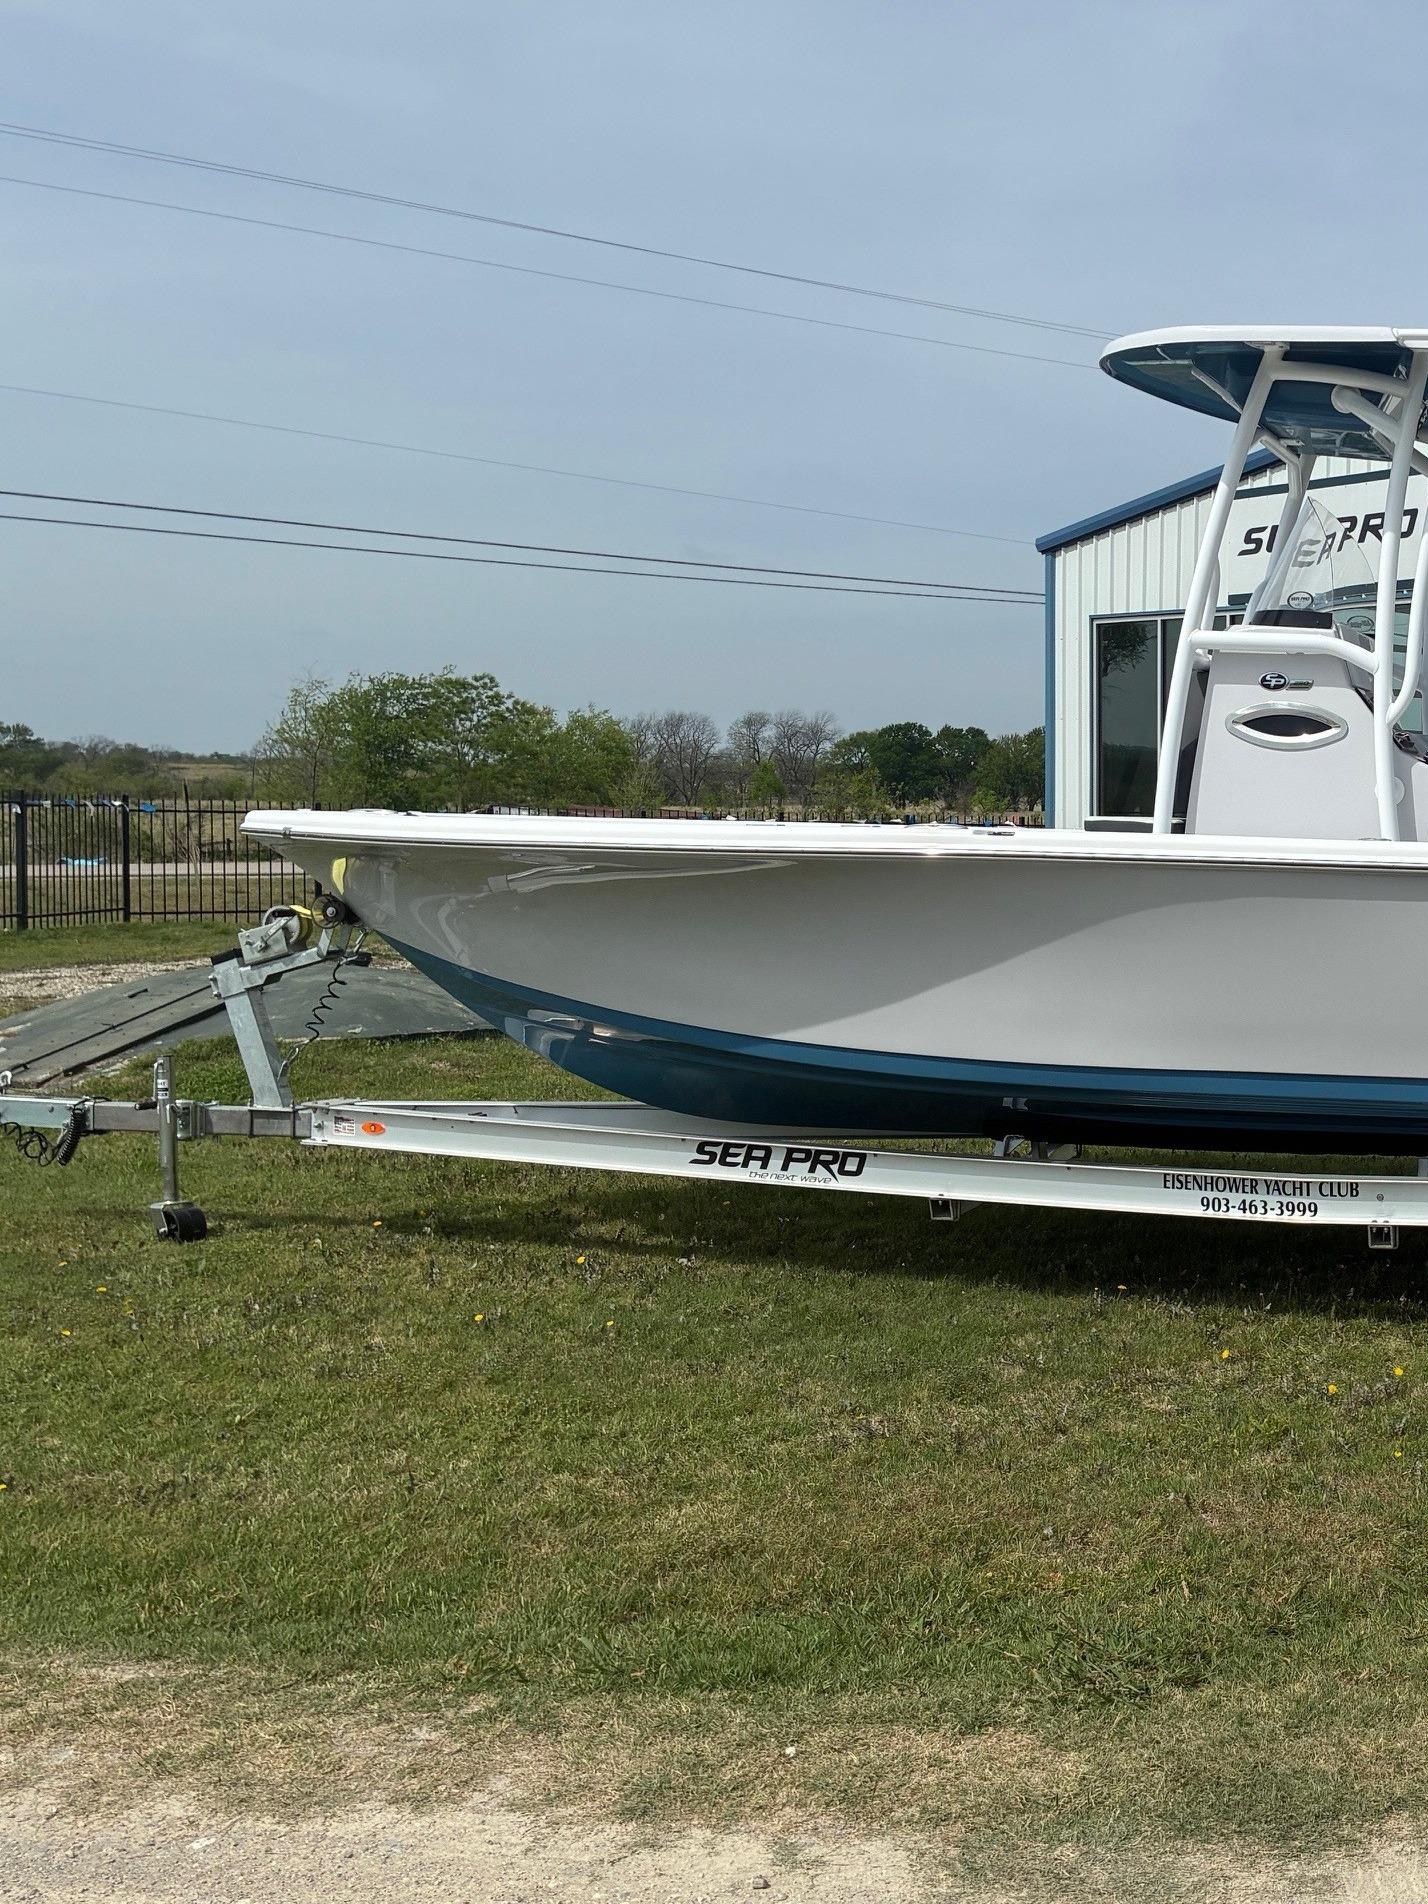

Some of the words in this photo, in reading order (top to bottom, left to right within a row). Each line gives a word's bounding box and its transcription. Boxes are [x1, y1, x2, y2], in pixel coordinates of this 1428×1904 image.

[688, 1141, 773, 1169] SEA
[780, 1148, 867, 1183] PRO
[748, 1171, 769, 1179] the
[770, 1172, 798, 1181] next
[800, 1175, 832, 1184] wave
[1163, 1173, 1259, 1195] EISENHOWER
[1263, 1179, 1312, 1197] YACHT
[1318, 1182, 1360, 1198] CLUB
[1200, 1196, 1318, 1217] 903-463-3999
